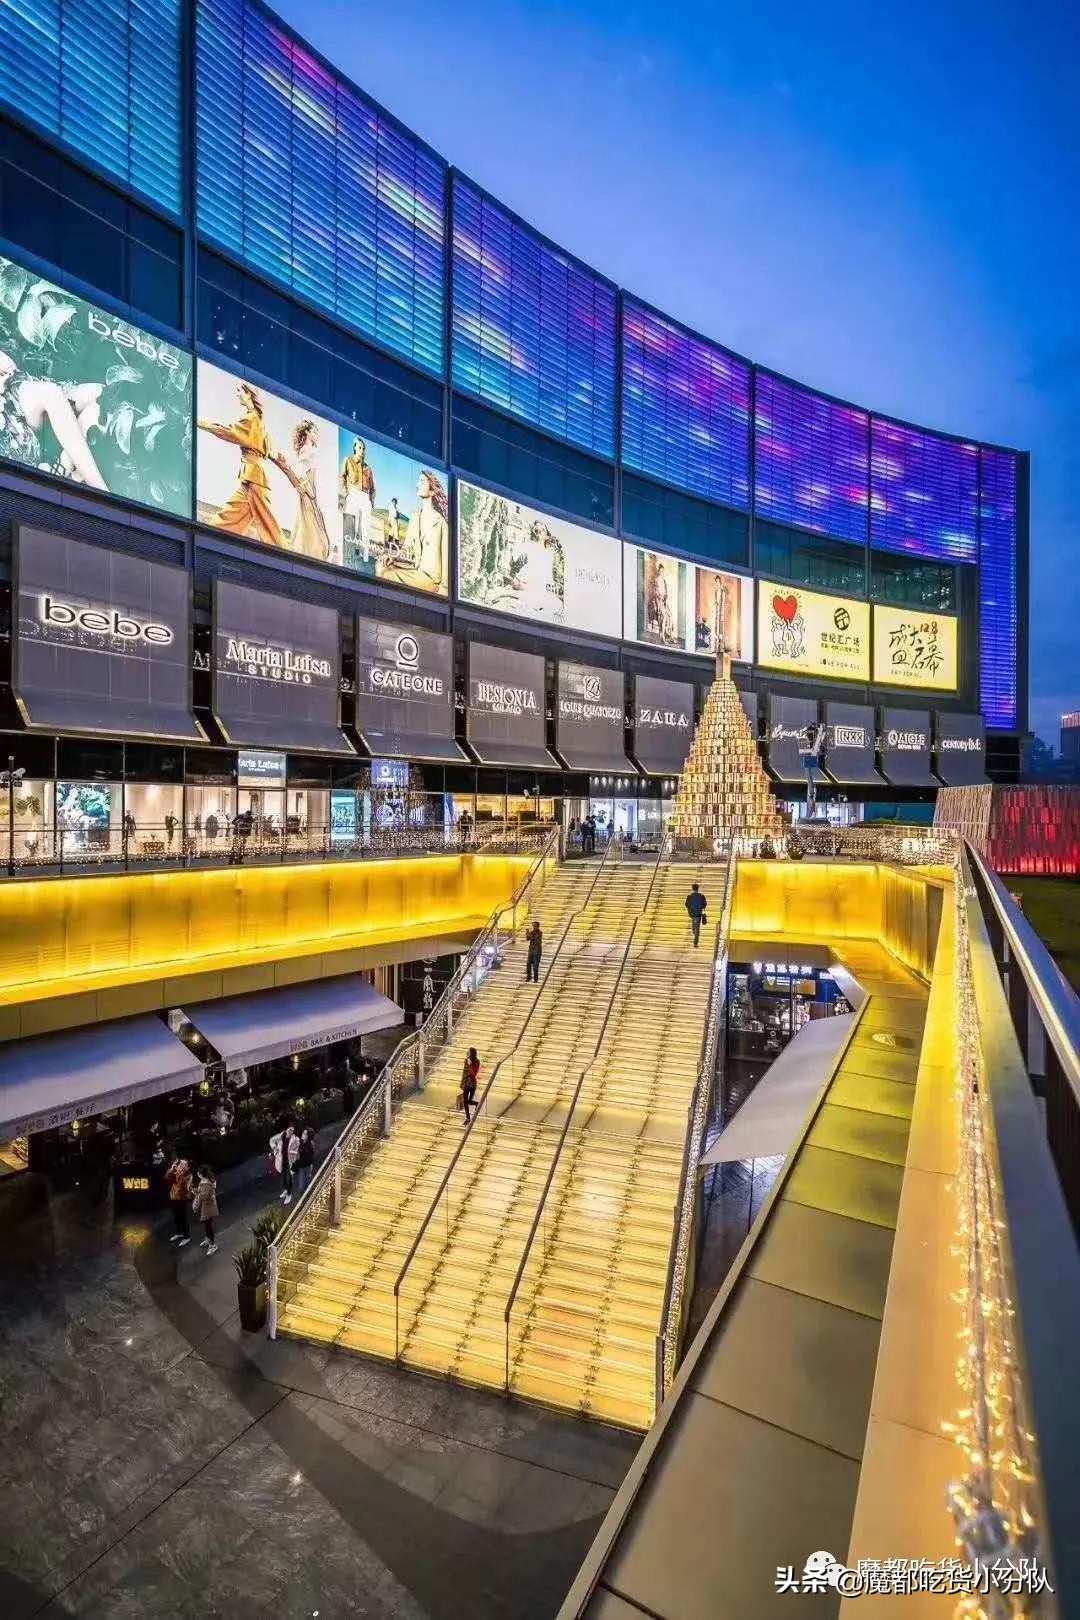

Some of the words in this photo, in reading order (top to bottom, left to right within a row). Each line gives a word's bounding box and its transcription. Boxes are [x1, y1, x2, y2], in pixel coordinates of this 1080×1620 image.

[88, 311, 180, 370] bebe
[41, 596, 173, 644] bebe
[226, 639, 283, 668] Maria
[284, 650, 330, 677] Luisa
[248, 664, 311, 684] STUDIO
[371, 669, 443, 695] GATEONE
[640, 708, 689, 727] ZARA
[897, 731, 926, 746] AIGLE
